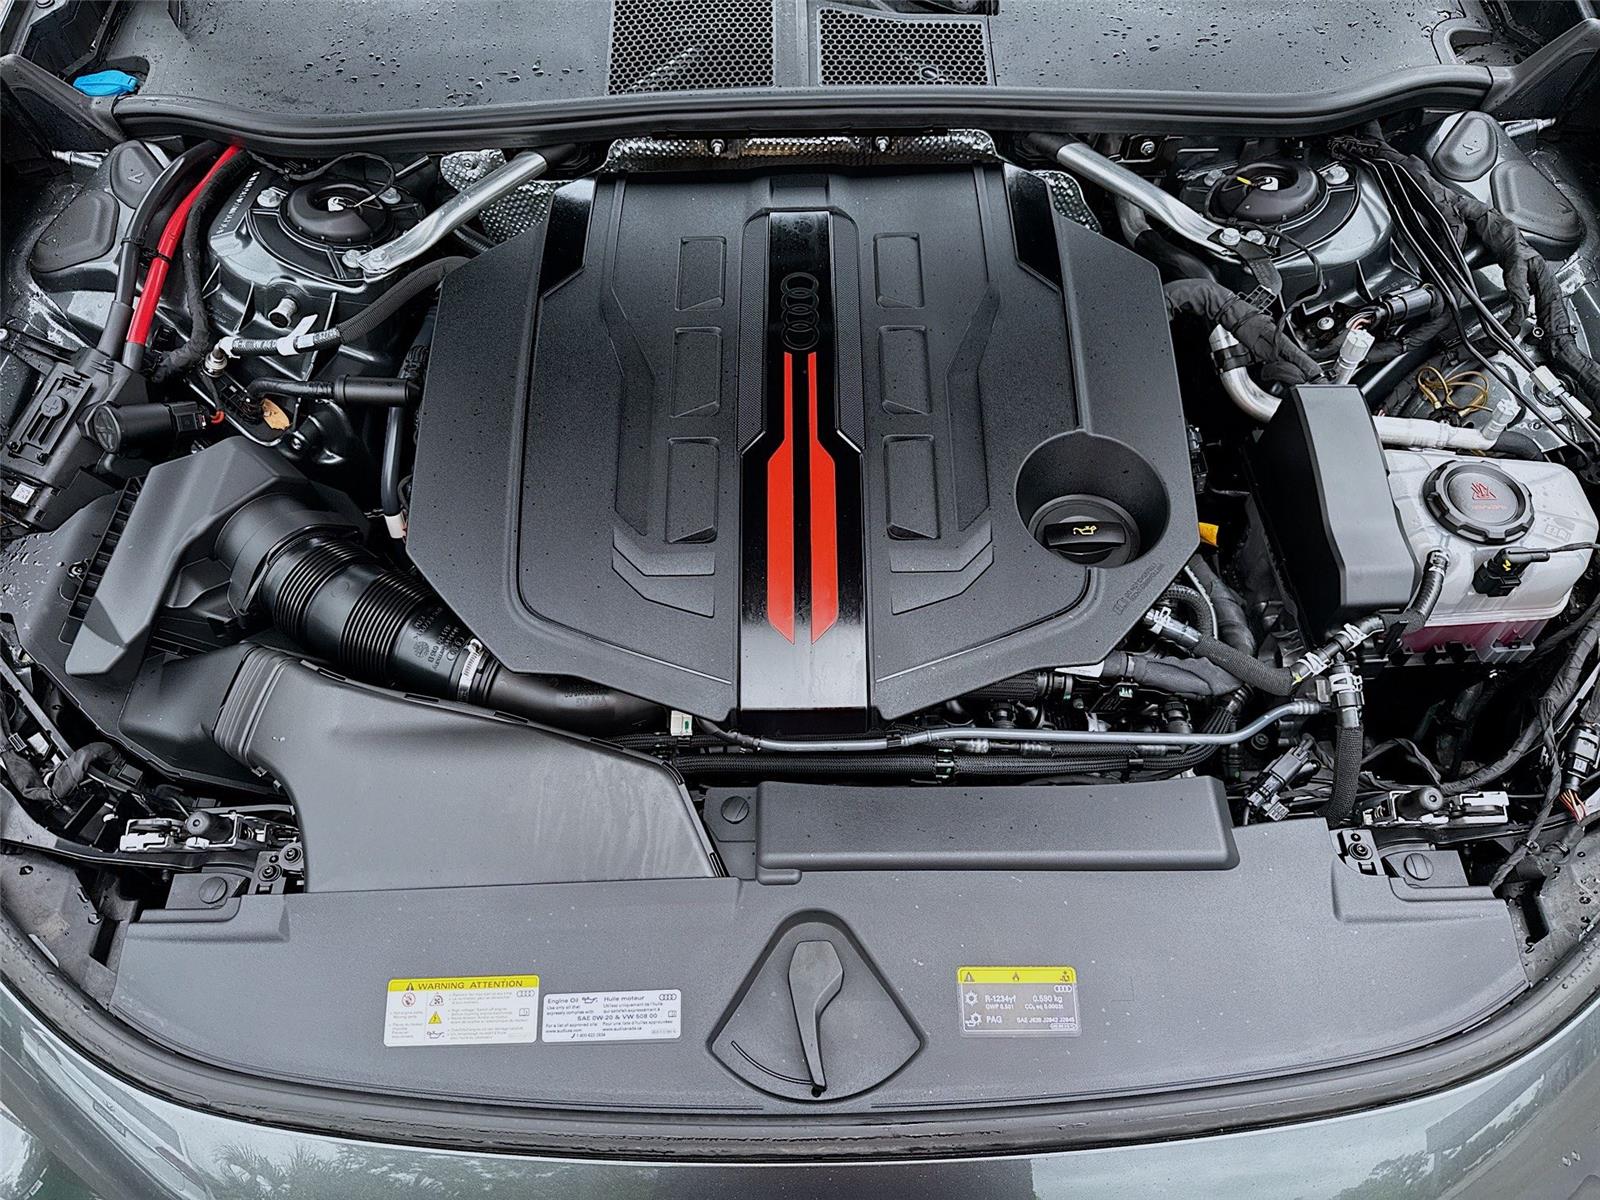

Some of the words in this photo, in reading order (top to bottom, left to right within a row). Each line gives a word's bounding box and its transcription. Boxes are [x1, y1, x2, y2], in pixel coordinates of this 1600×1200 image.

[417, 981, 465, 990] WARNING
[469, 980, 523, 989] ATTENTION
[985, 994, 1016, 1004] R-1234yf
[1053, 994, 1063, 1004] kg
[986, 1015, 1002, 1024] PAG
